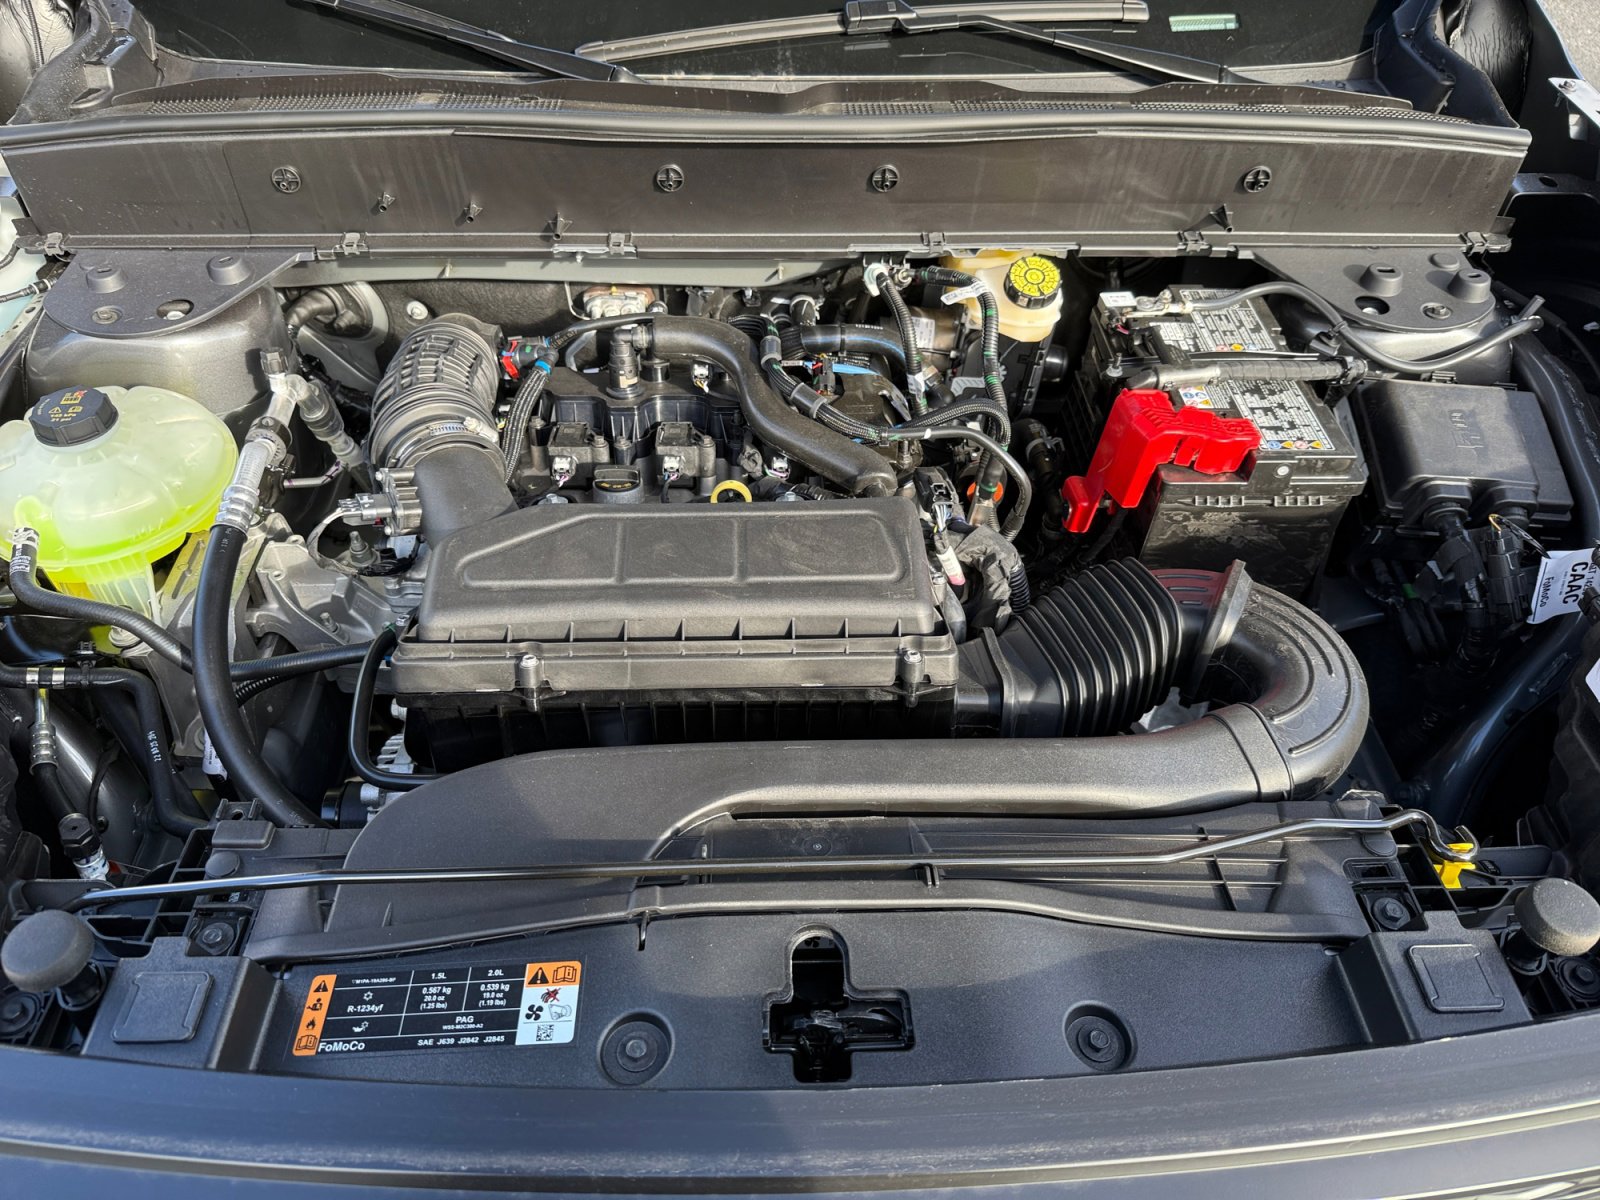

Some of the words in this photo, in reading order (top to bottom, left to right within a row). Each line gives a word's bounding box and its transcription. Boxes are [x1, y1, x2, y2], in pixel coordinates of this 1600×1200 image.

[1562, 561, 1589, 605] CAAC
[1539, 576, 1555, 608] FoMoCo
[431, 972, 447, 980] 1.5L
[487, 969, 504, 977] 2.0L
[422, 986, 441, 994] 0.567
[442, 986, 452, 995] kg
[480, 983, 499, 991] 0.539
[500, 983, 510, 992] kg
[346, 1003, 384, 1013] R-1234yf
[420, 1003, 435, 1011] (1.25
[455, 1015, 475, 1024] PAG
[417, 1038, 434, 1046] SAE
[436, 1037, 455, 1045] J639
[457, 1036, 480, 1044] J2842
[483, 1035, 505, 1043] J2845
[318, 1040, 366, 1052] FoMoCo
